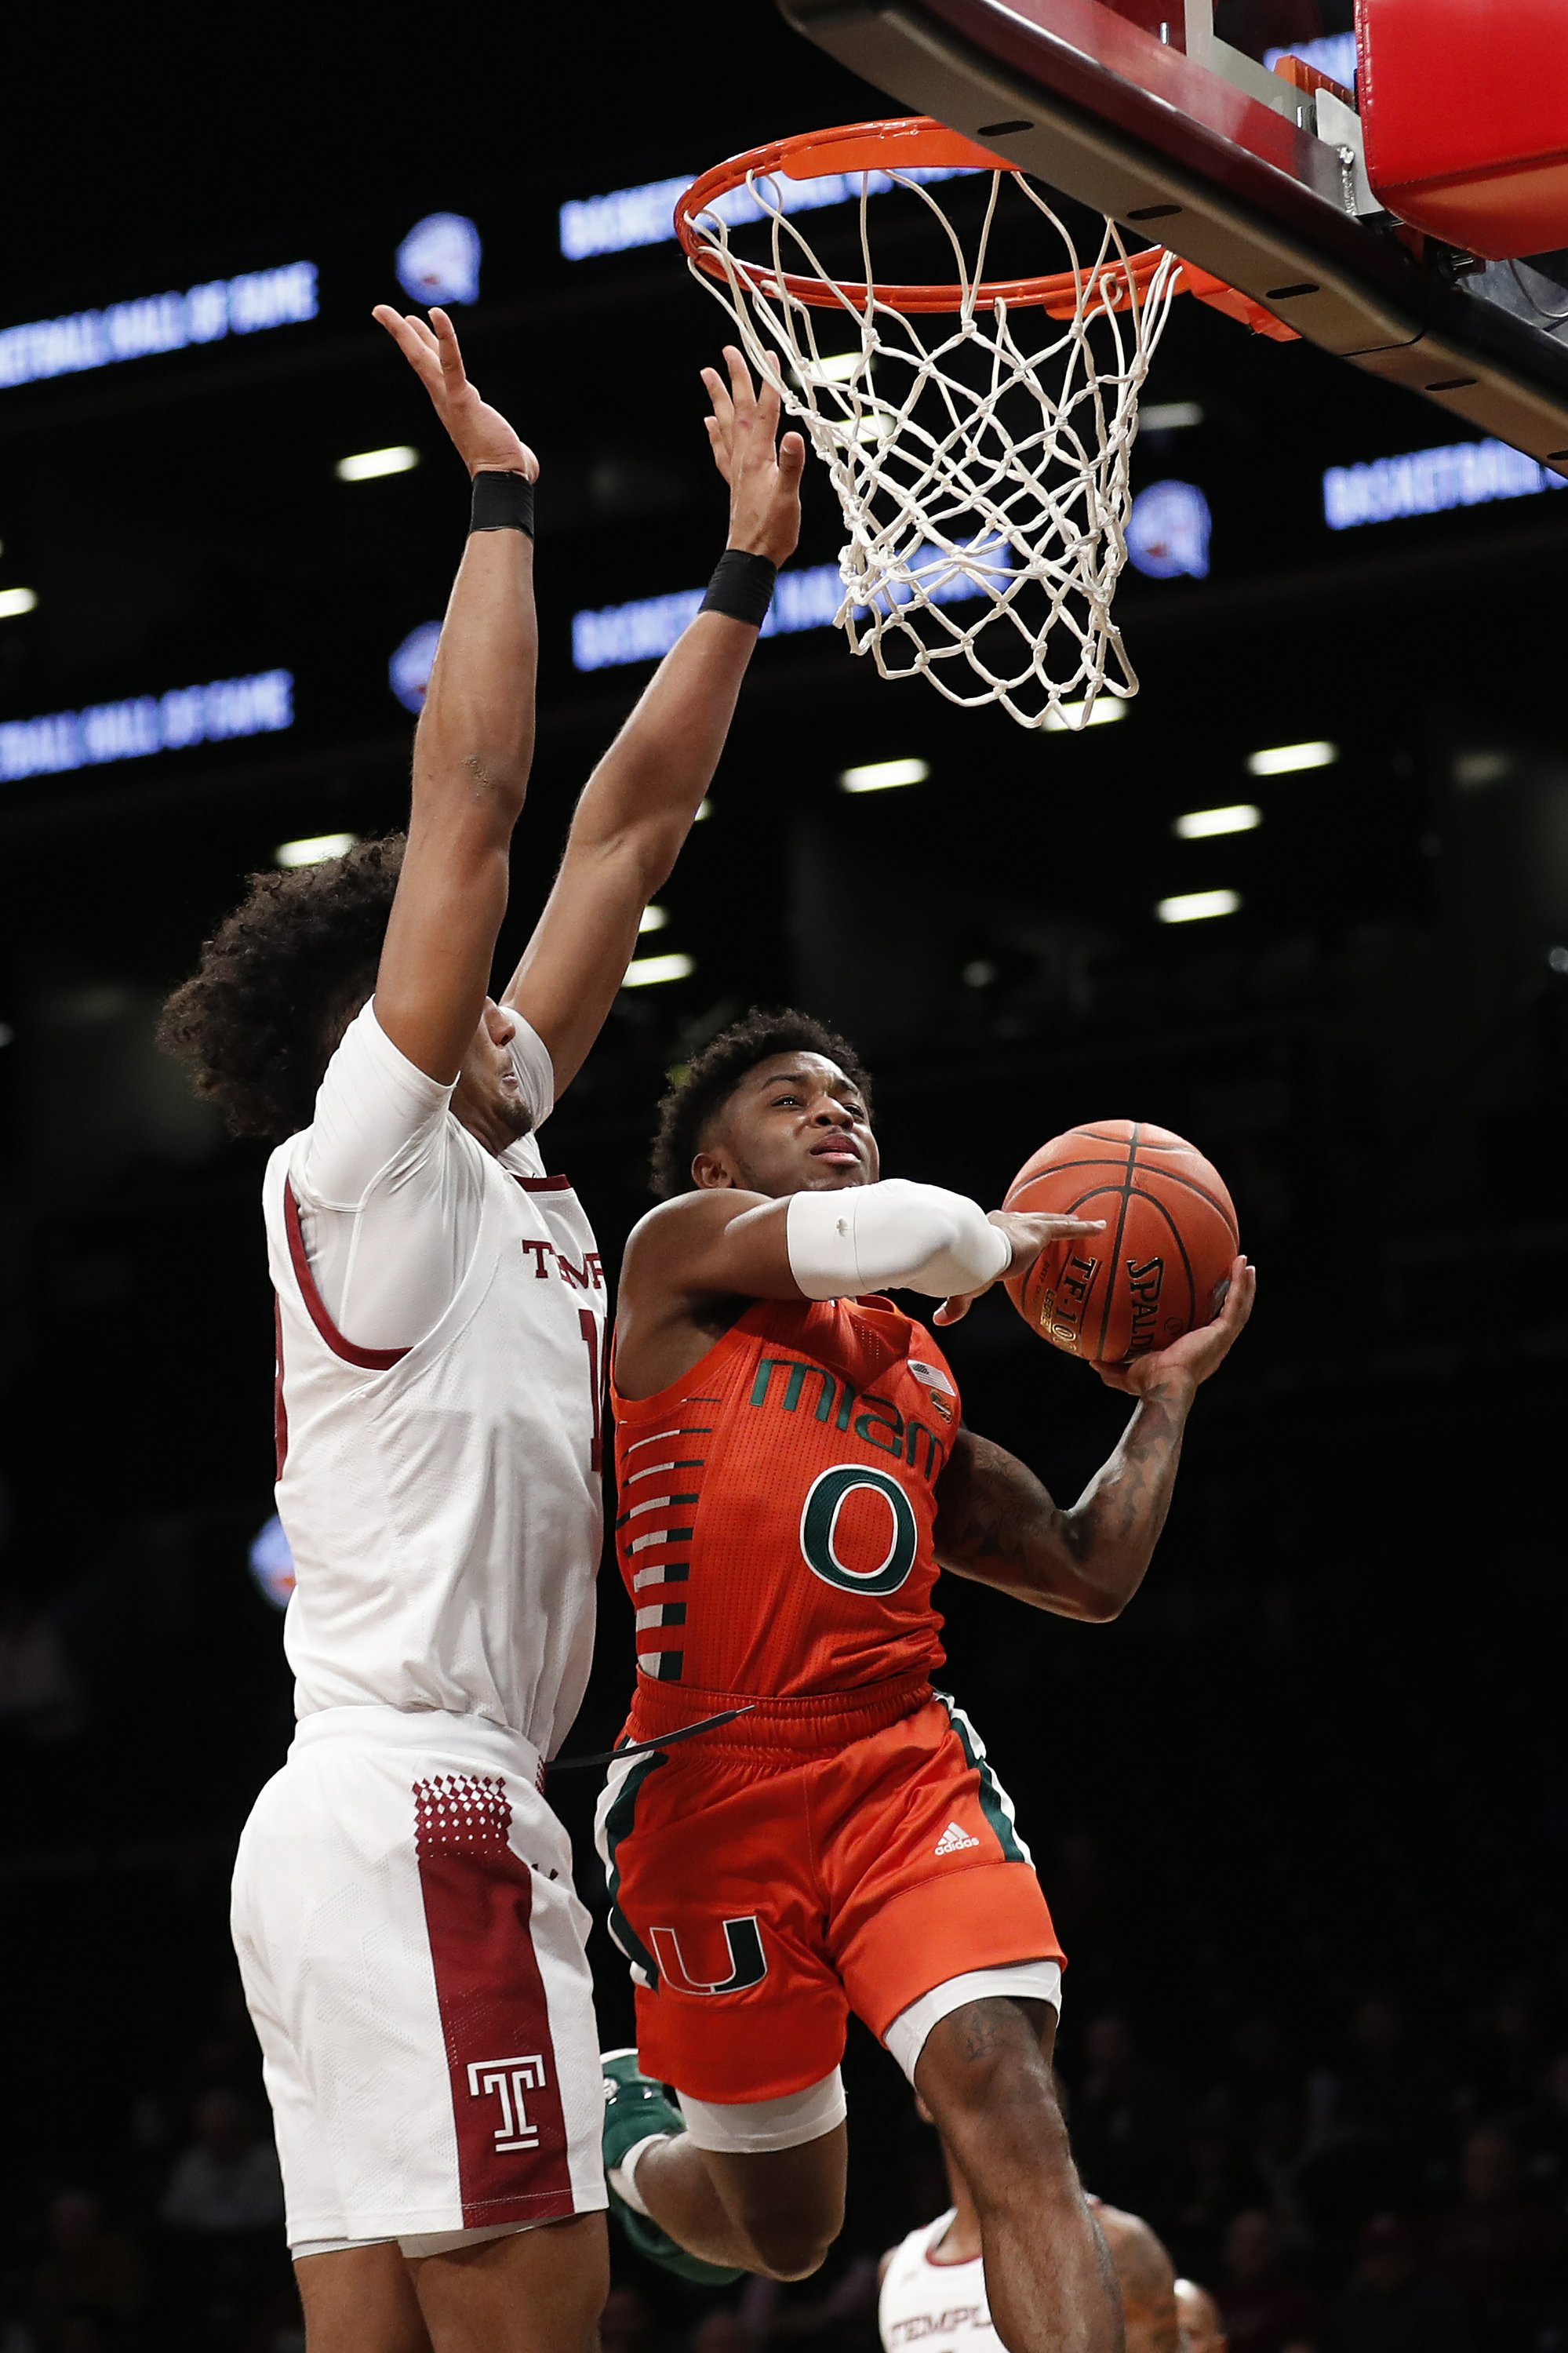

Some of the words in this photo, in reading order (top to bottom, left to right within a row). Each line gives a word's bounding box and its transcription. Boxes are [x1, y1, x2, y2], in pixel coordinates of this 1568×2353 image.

[934, 1837, 980, 1856] adidas
[649, 1915, 767, 1995] U
[467, 2054, 546, 2152] T
